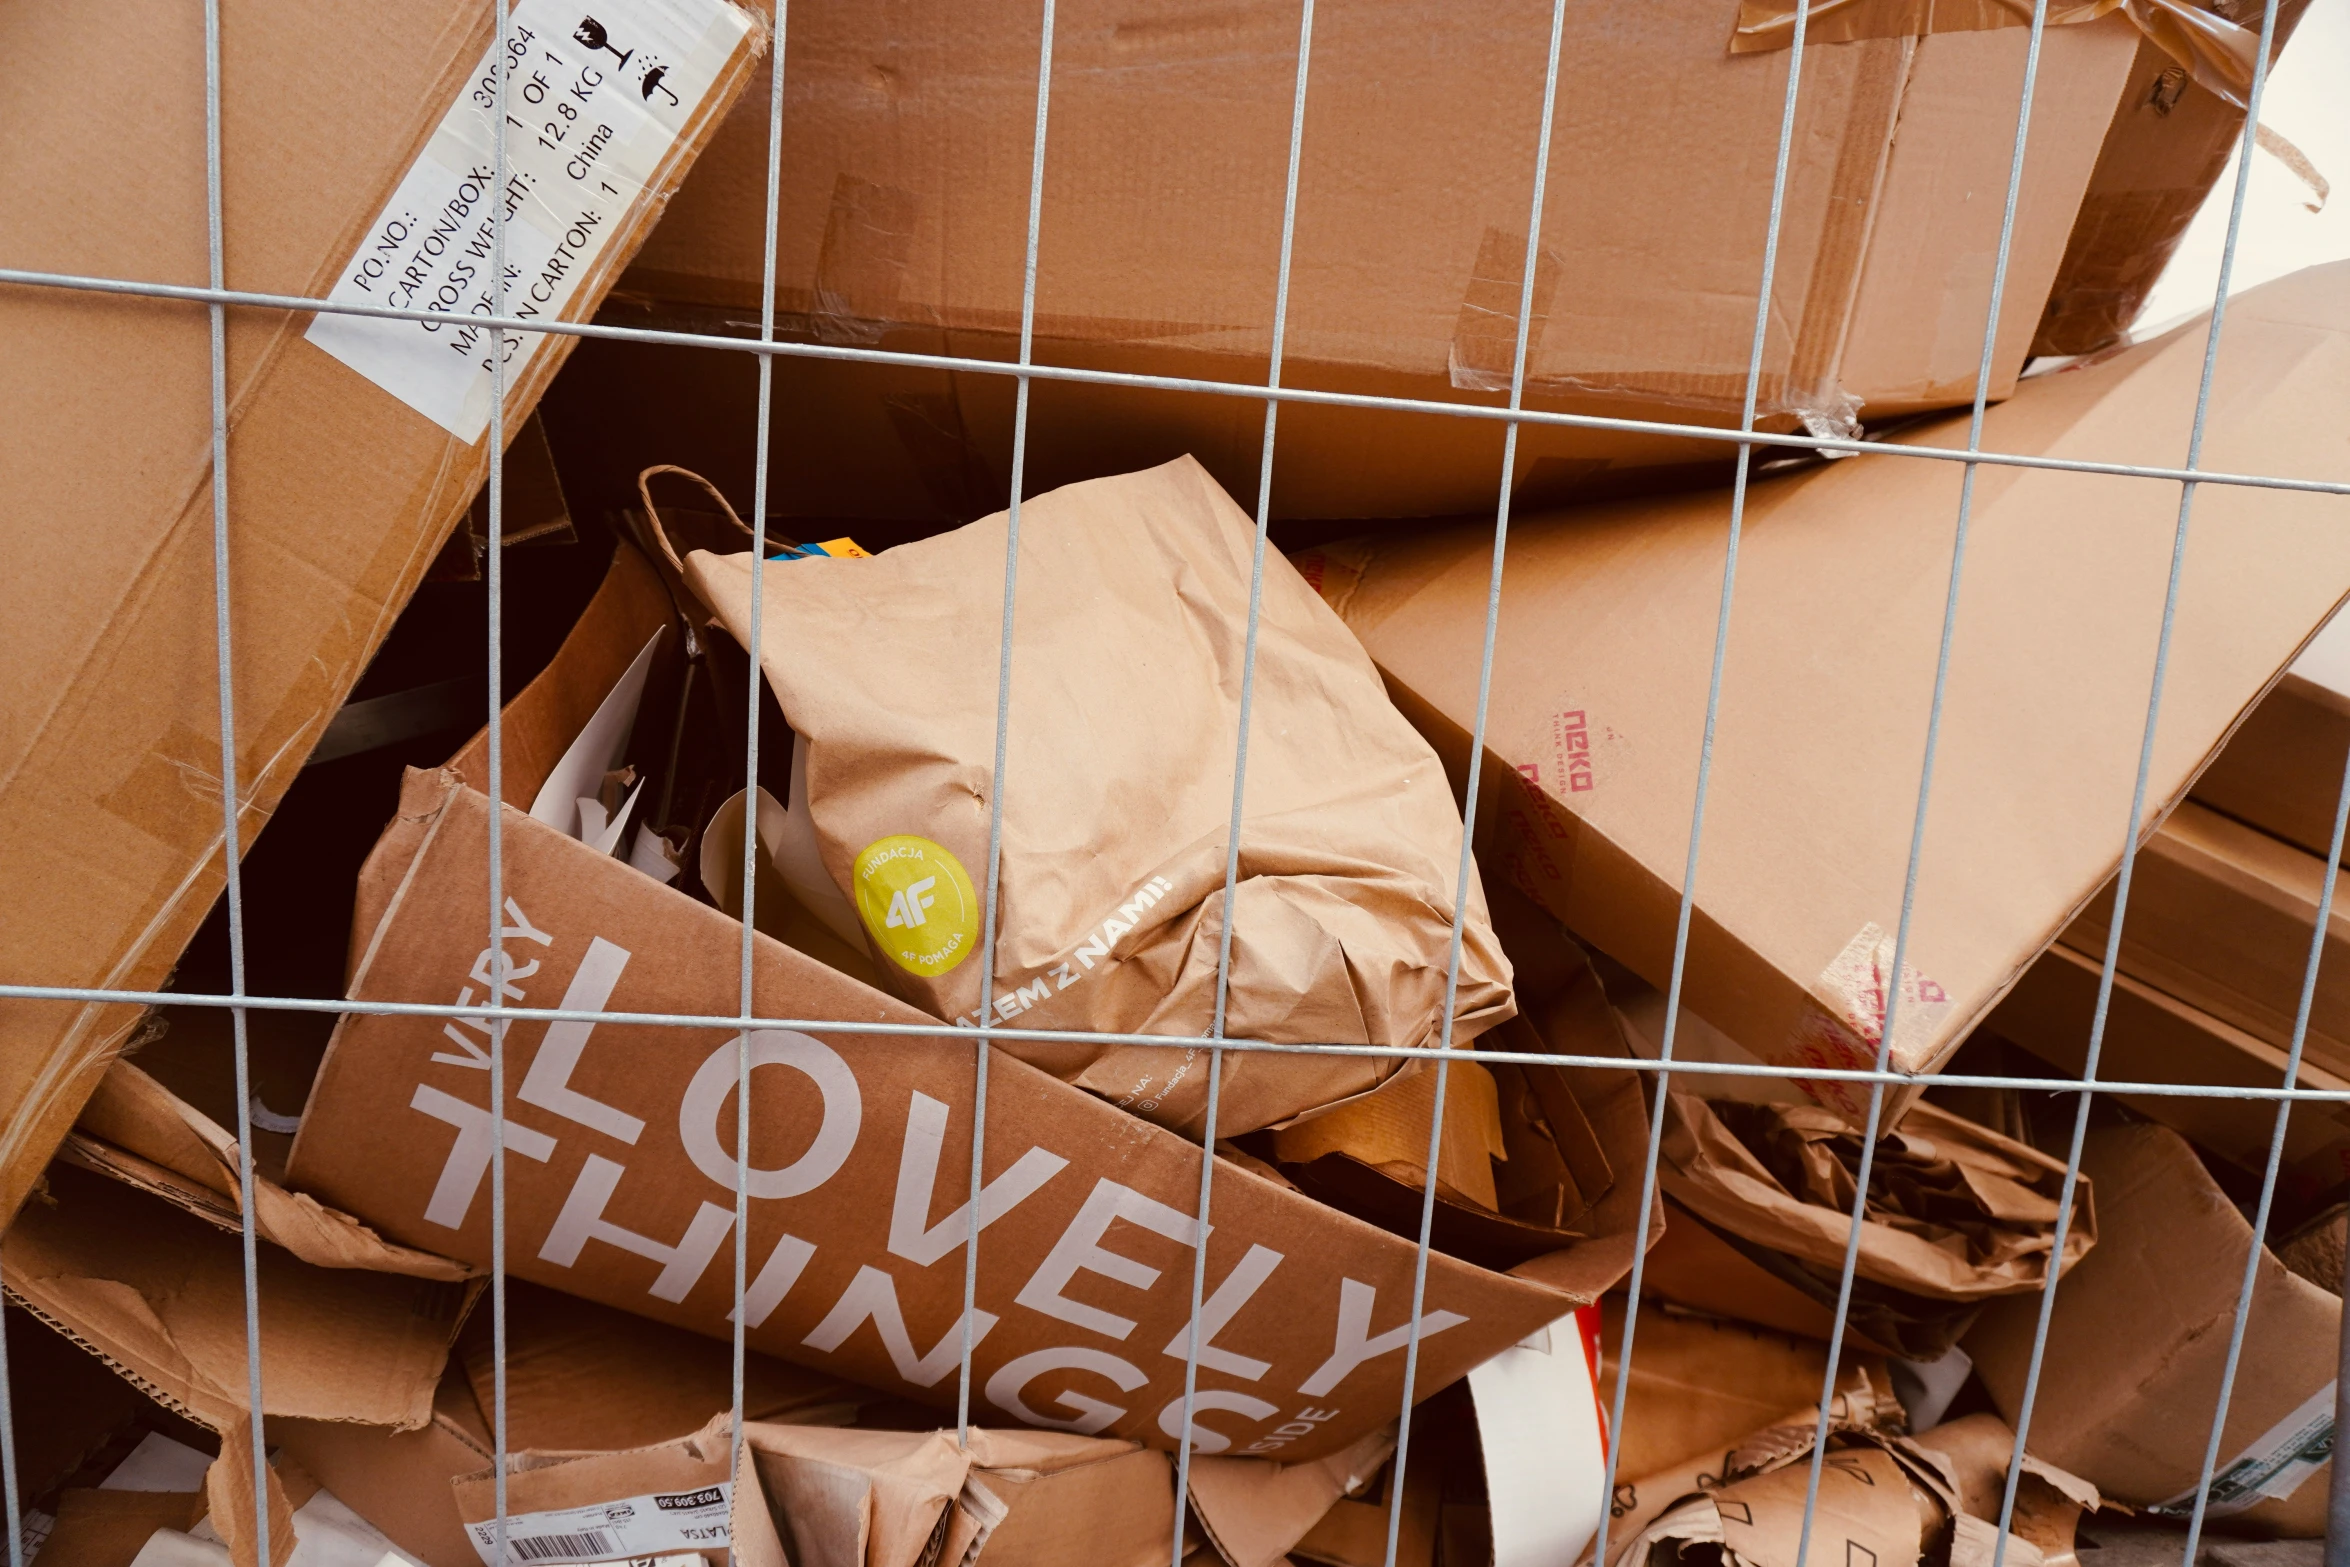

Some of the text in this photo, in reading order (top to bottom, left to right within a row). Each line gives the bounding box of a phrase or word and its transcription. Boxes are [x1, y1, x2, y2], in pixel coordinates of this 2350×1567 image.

[538, 103, 577, 150] 12.8
[570, 66, 603, 103] KG
[388, 51, 563, 309] CARTON/BOX: 1 OF 1
[566, 123, 614, 181] China
[531, 210, 602, 302] CARTON:
[600, 181, 618, 195] 1
[1552, 713, 1567, 795] THINK DESIGN
[862, 846, 924, 882] FUNDACJA
[885, 875, 936, 929] 4F
[901, 932, 964, 965] 4F POMAGA
[1047, 961, 1082, 991] Z
[1073, 875, 1174, 970] NAMI!
[429, 896, 554, 1071] VERY
[1131, 1074, 1153, 1096] NA:
[516, 935, 1472, 1398] LOVELY
[409, 1083, 1281, 1455] THINGS
[658, 1489, 721, 1508] 703.309.50
